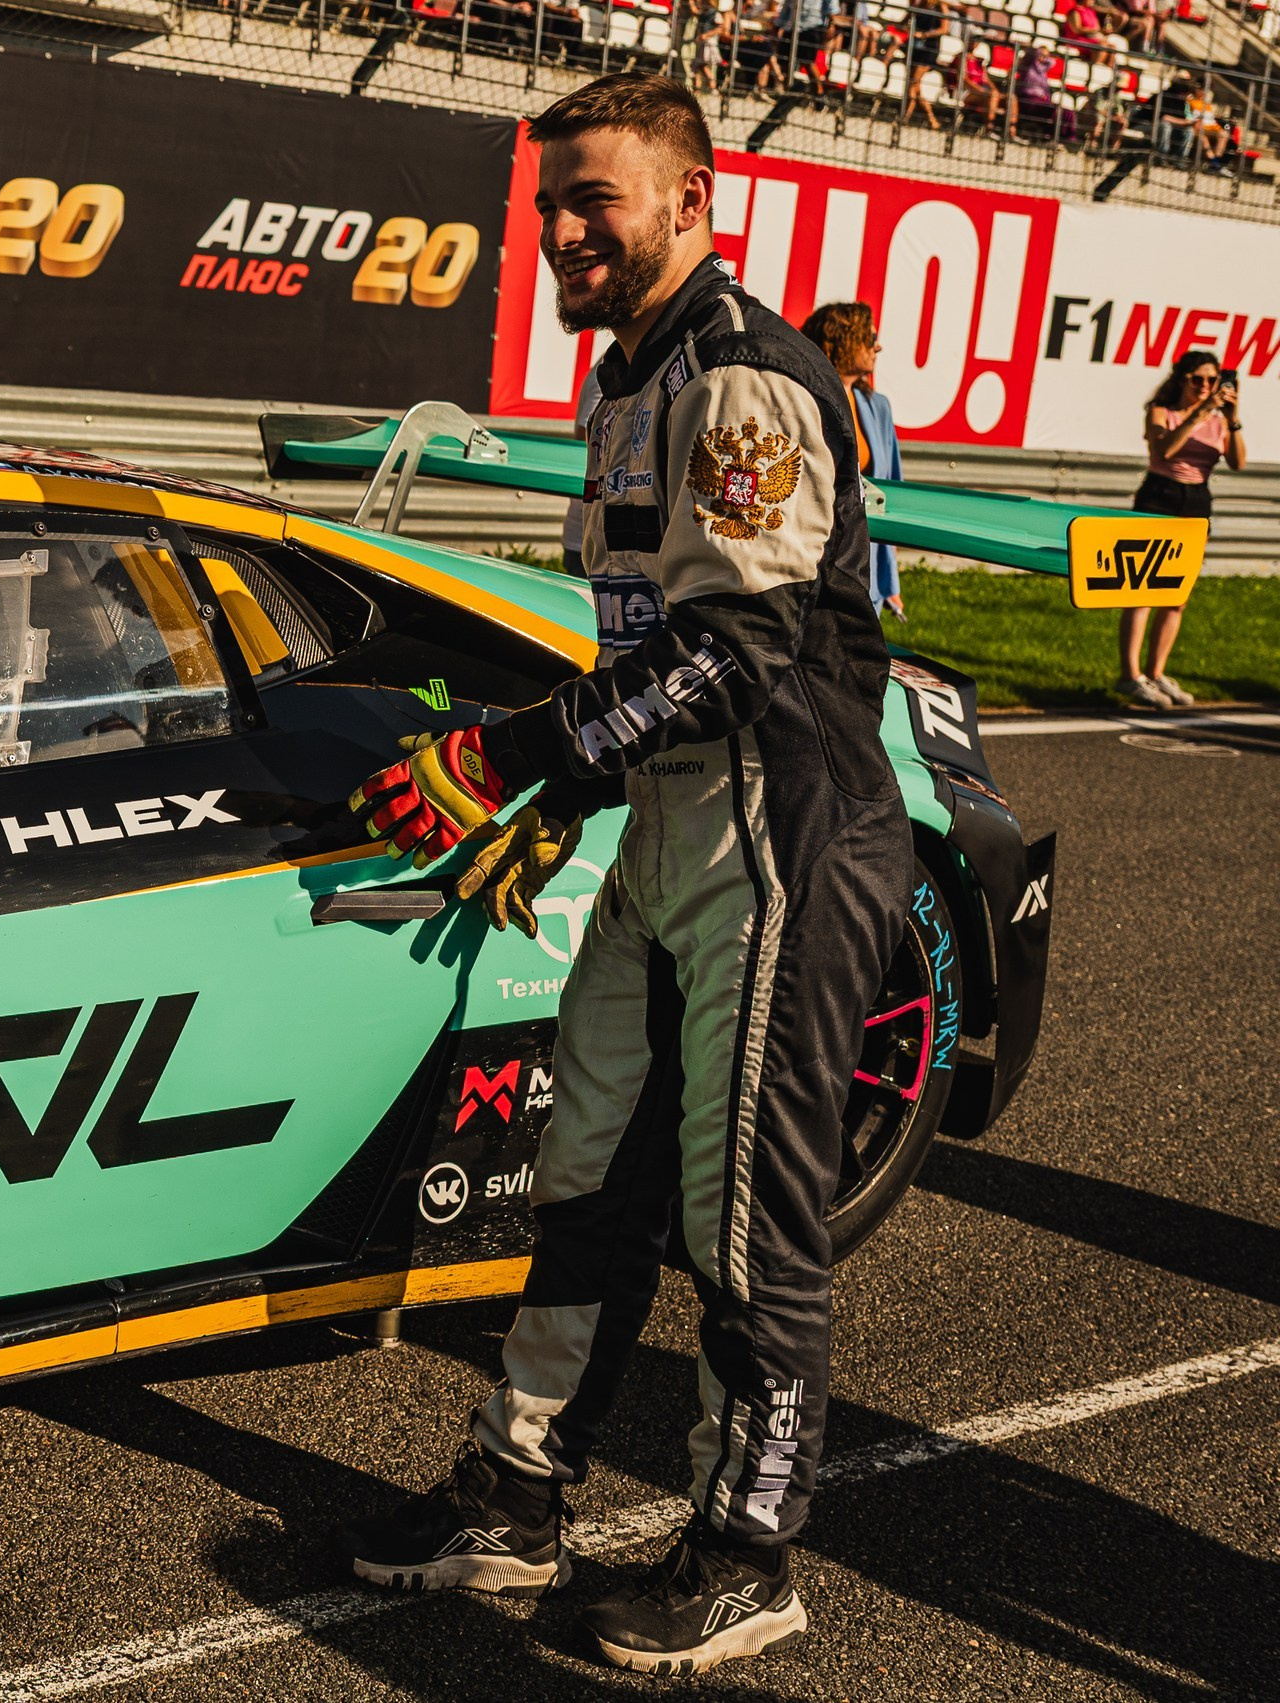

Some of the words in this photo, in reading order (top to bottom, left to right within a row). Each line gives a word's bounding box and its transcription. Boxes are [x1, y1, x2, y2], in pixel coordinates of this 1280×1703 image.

[197, 198, 373, 262] АВТО
[180, 255, 309, 296] ПЛЮС
[352, 217, 480, 308] 20
[1044, 295, 1280, 377] F1NEW
[1085, 539, 1186, 591] SVL
[463, 754, 482, 777] DDE
[648, 760, 705, 777] KHAIROV
